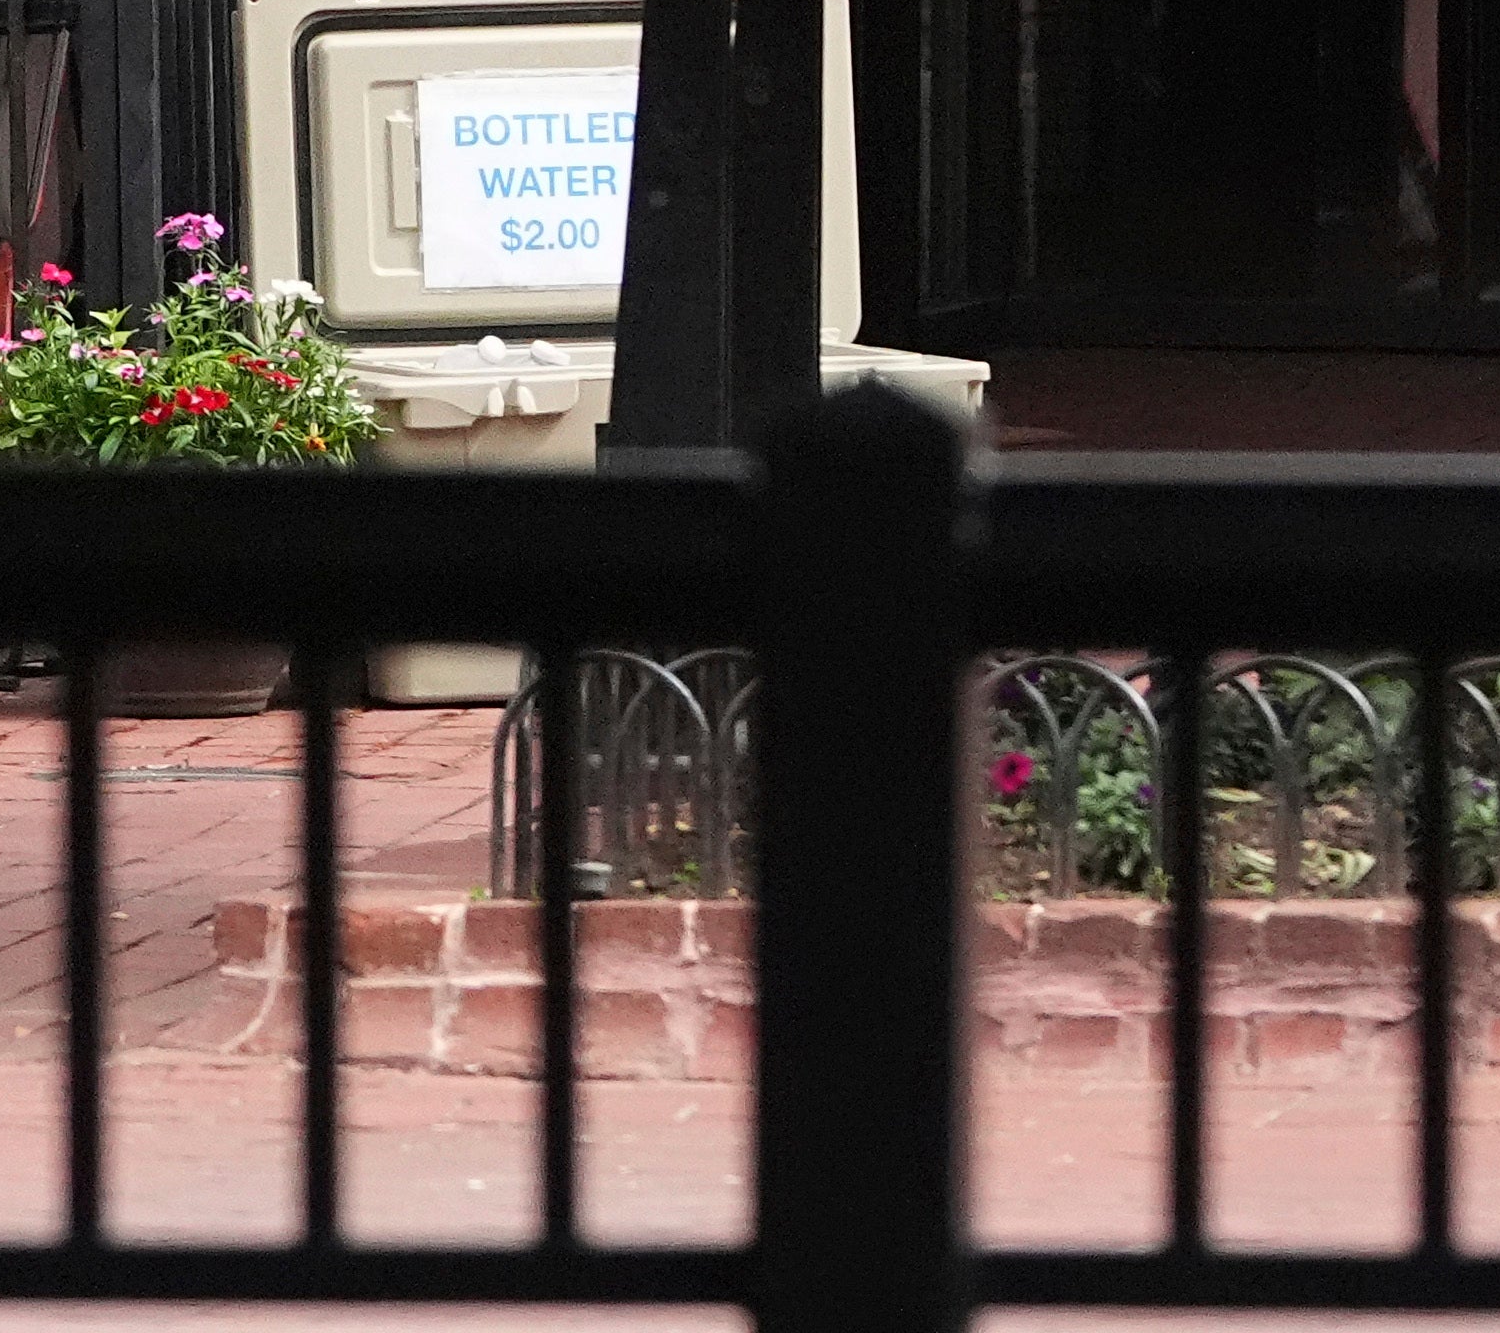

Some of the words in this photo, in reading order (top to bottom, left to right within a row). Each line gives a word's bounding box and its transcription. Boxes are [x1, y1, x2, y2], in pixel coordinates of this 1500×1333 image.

[453, 111, 637, 147] BOTTLED
[478, 165, 617, 199] WATER
[500, 216, 600, 255] $2.00
